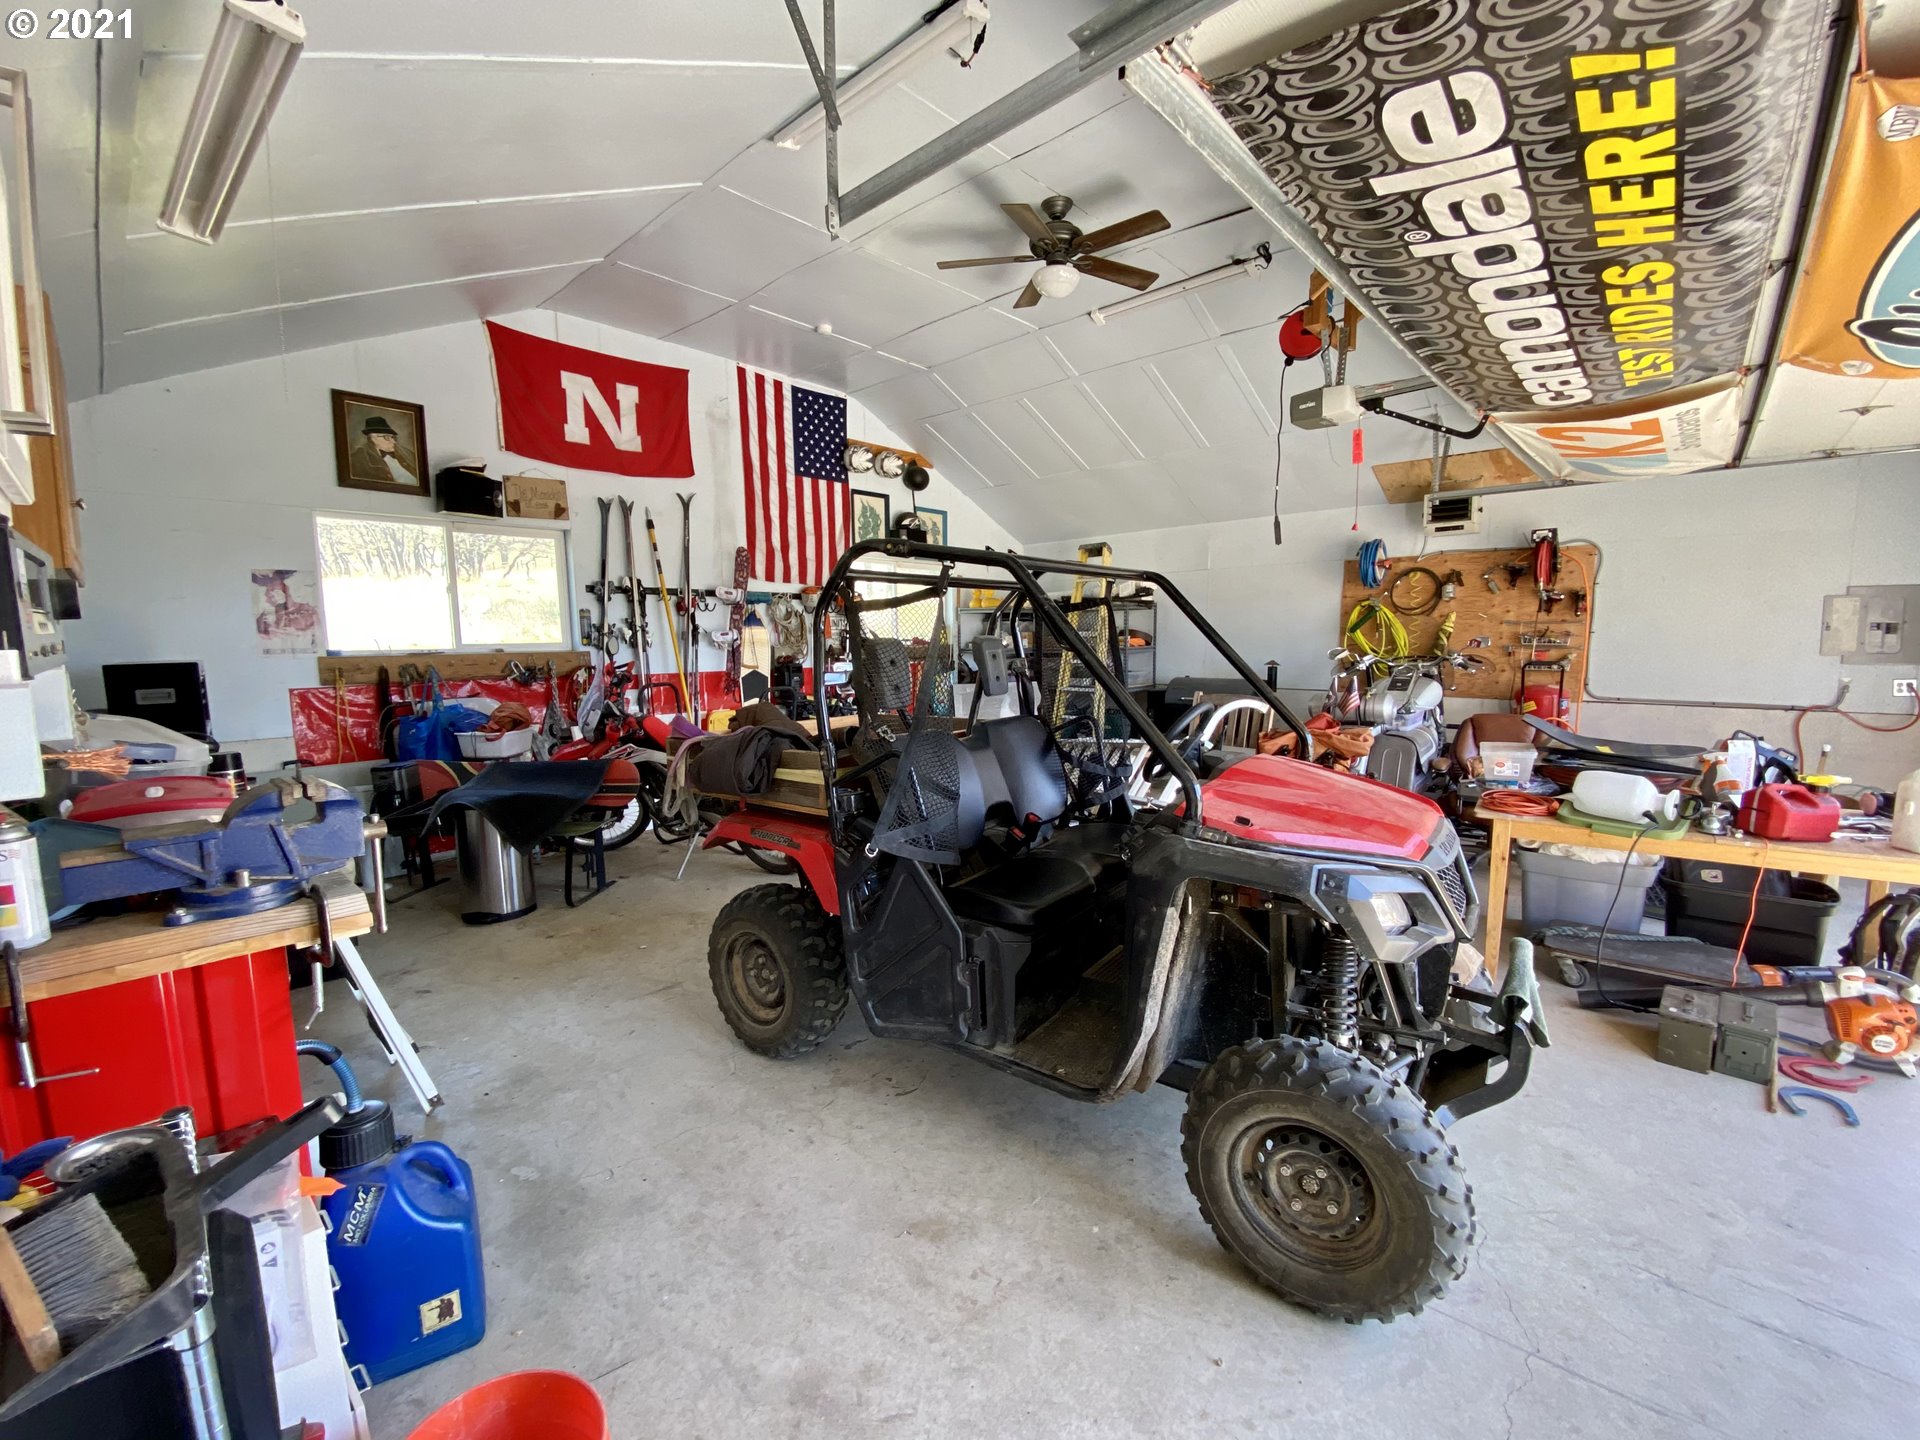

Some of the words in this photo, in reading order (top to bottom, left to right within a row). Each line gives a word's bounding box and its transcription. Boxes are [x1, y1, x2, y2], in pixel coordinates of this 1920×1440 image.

[1570, 46, 1677, 247] HERE!
[1368, 70, 1594, 406] cannondale
[1602, 261, 1676, 343] RIDES
[1619, 346, 1675, 388] TEST
[559, 370, 643, 453] N
[1536, 417, 1667, 458] K2
[343, 1191, 367, 1242] MCM
